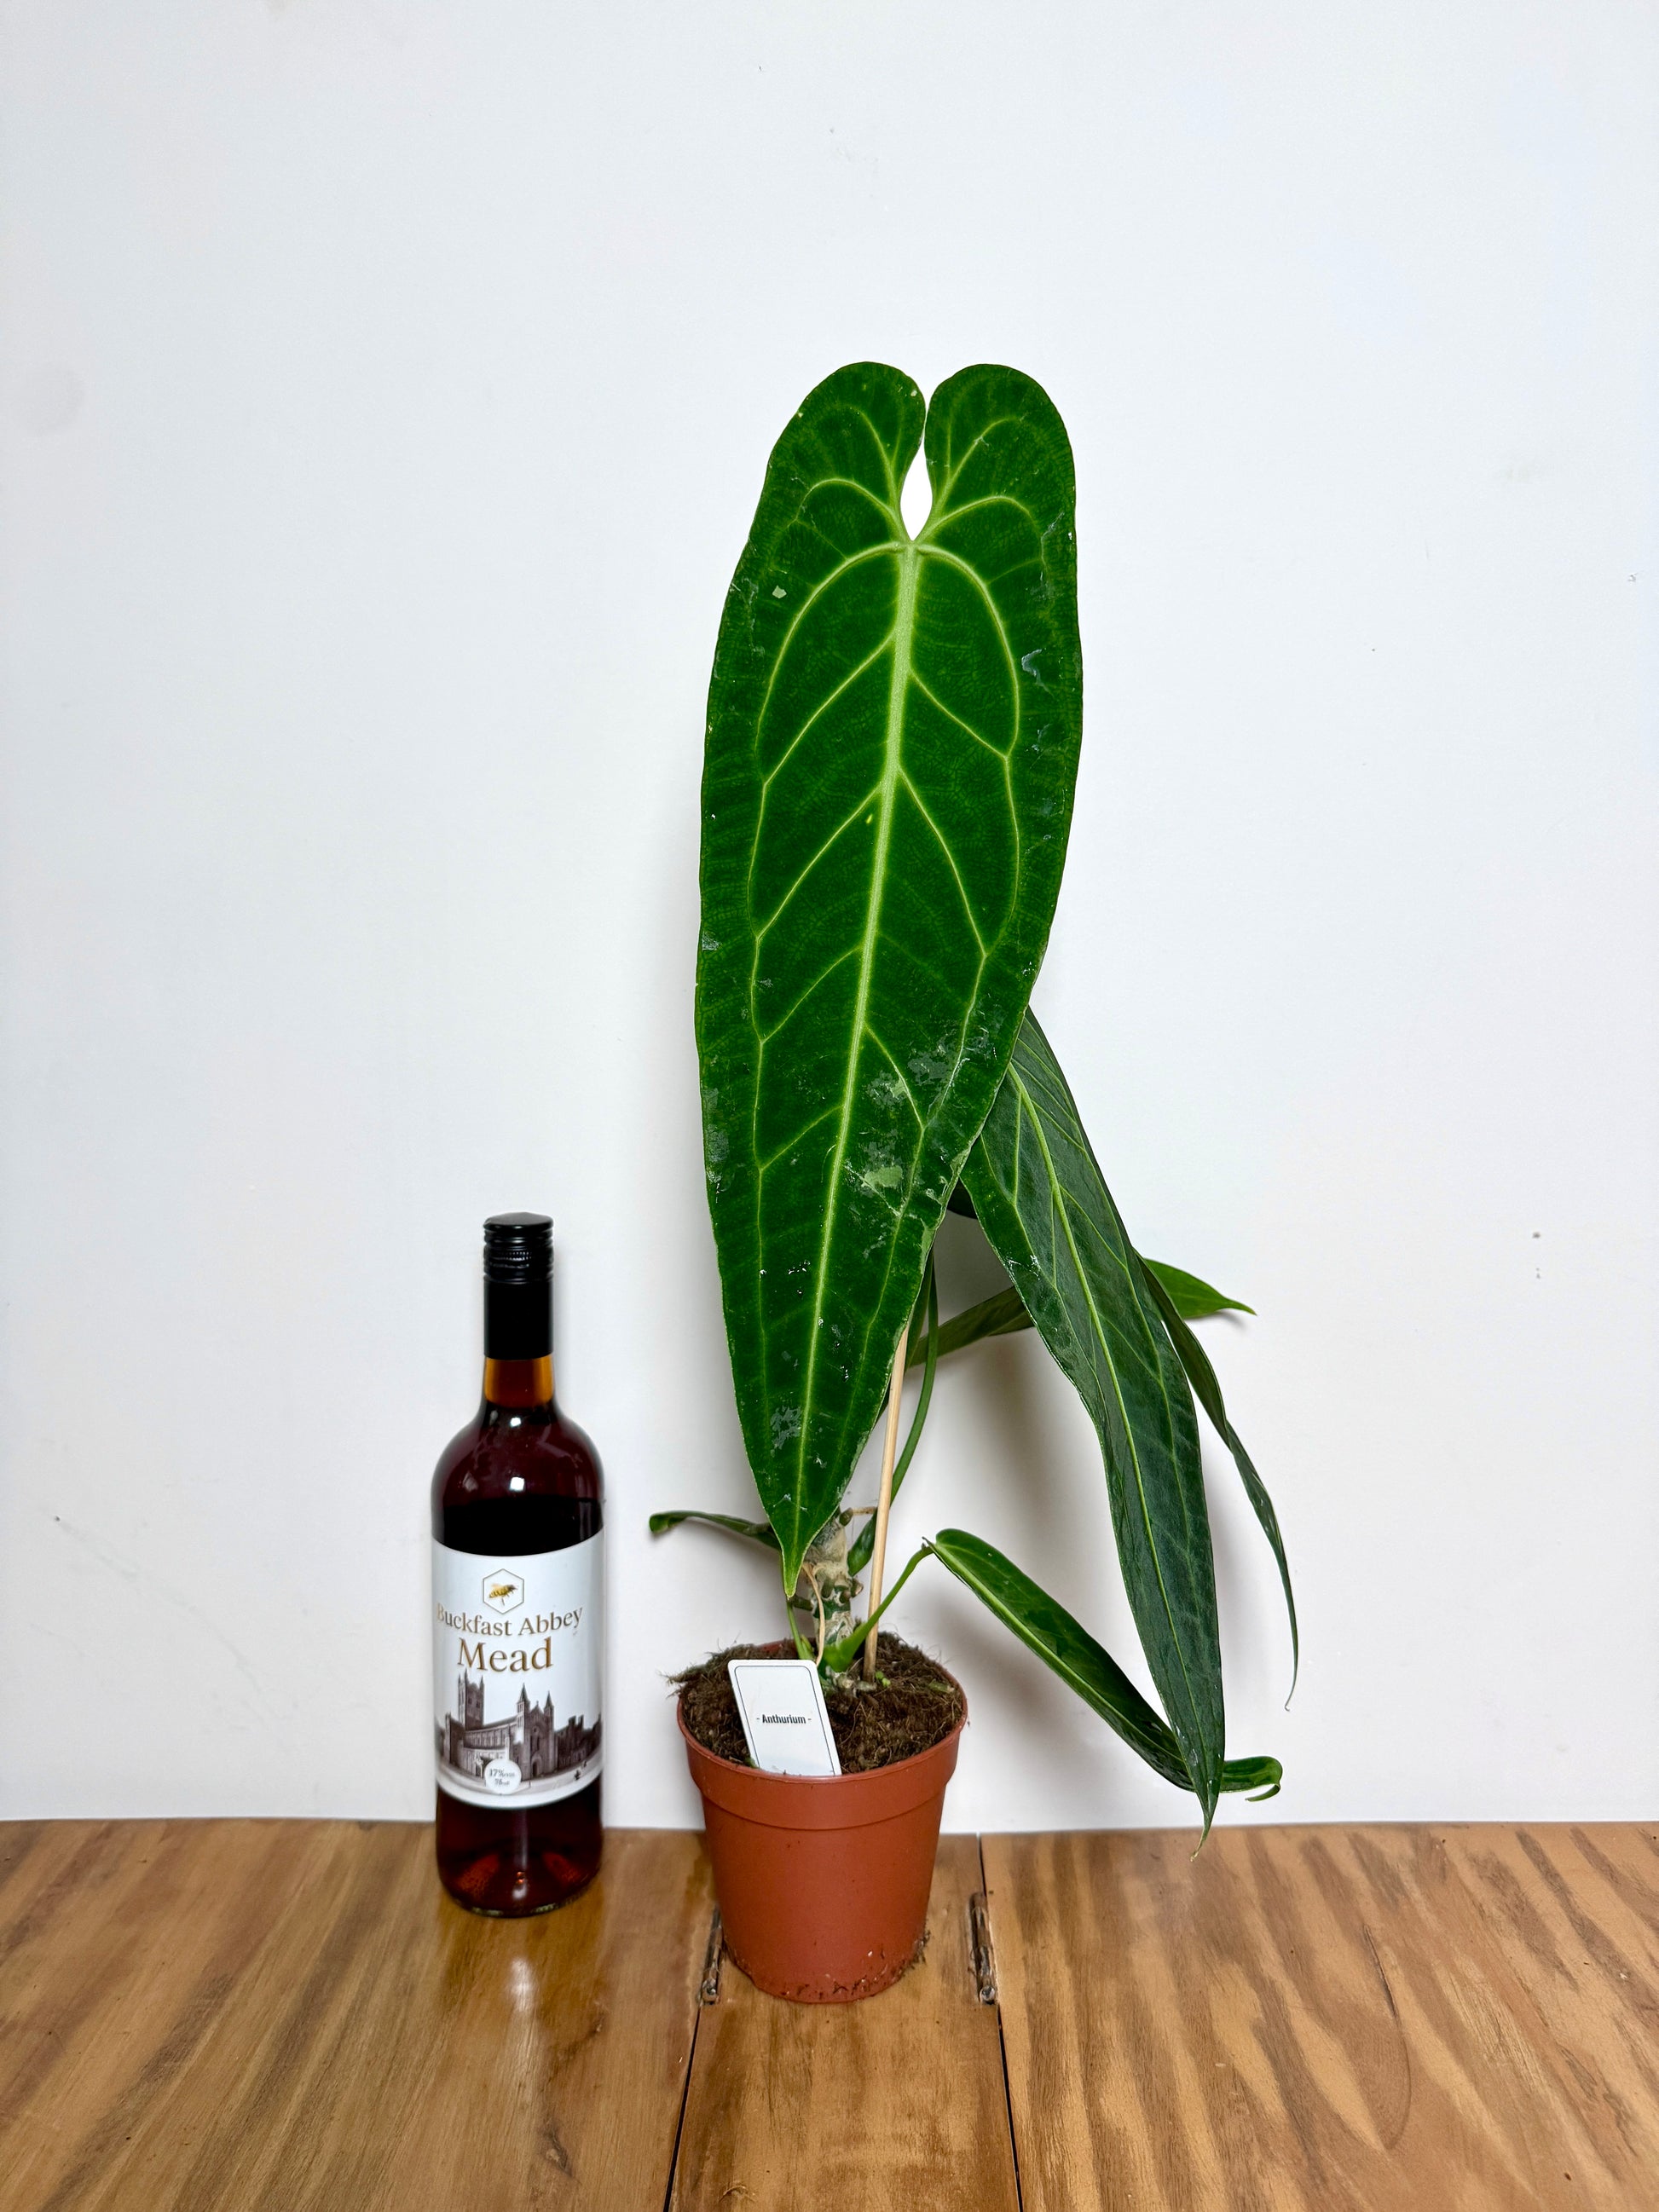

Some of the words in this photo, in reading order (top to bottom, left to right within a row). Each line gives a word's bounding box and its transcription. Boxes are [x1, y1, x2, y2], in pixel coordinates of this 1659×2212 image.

[436, 1603, 512, 1636] Buckfast
[518, 1607, 583, 1636] Abbey
[458, 1636, 553, 1672] Mead
[762, 1714, 806, 1724] Anthurium
